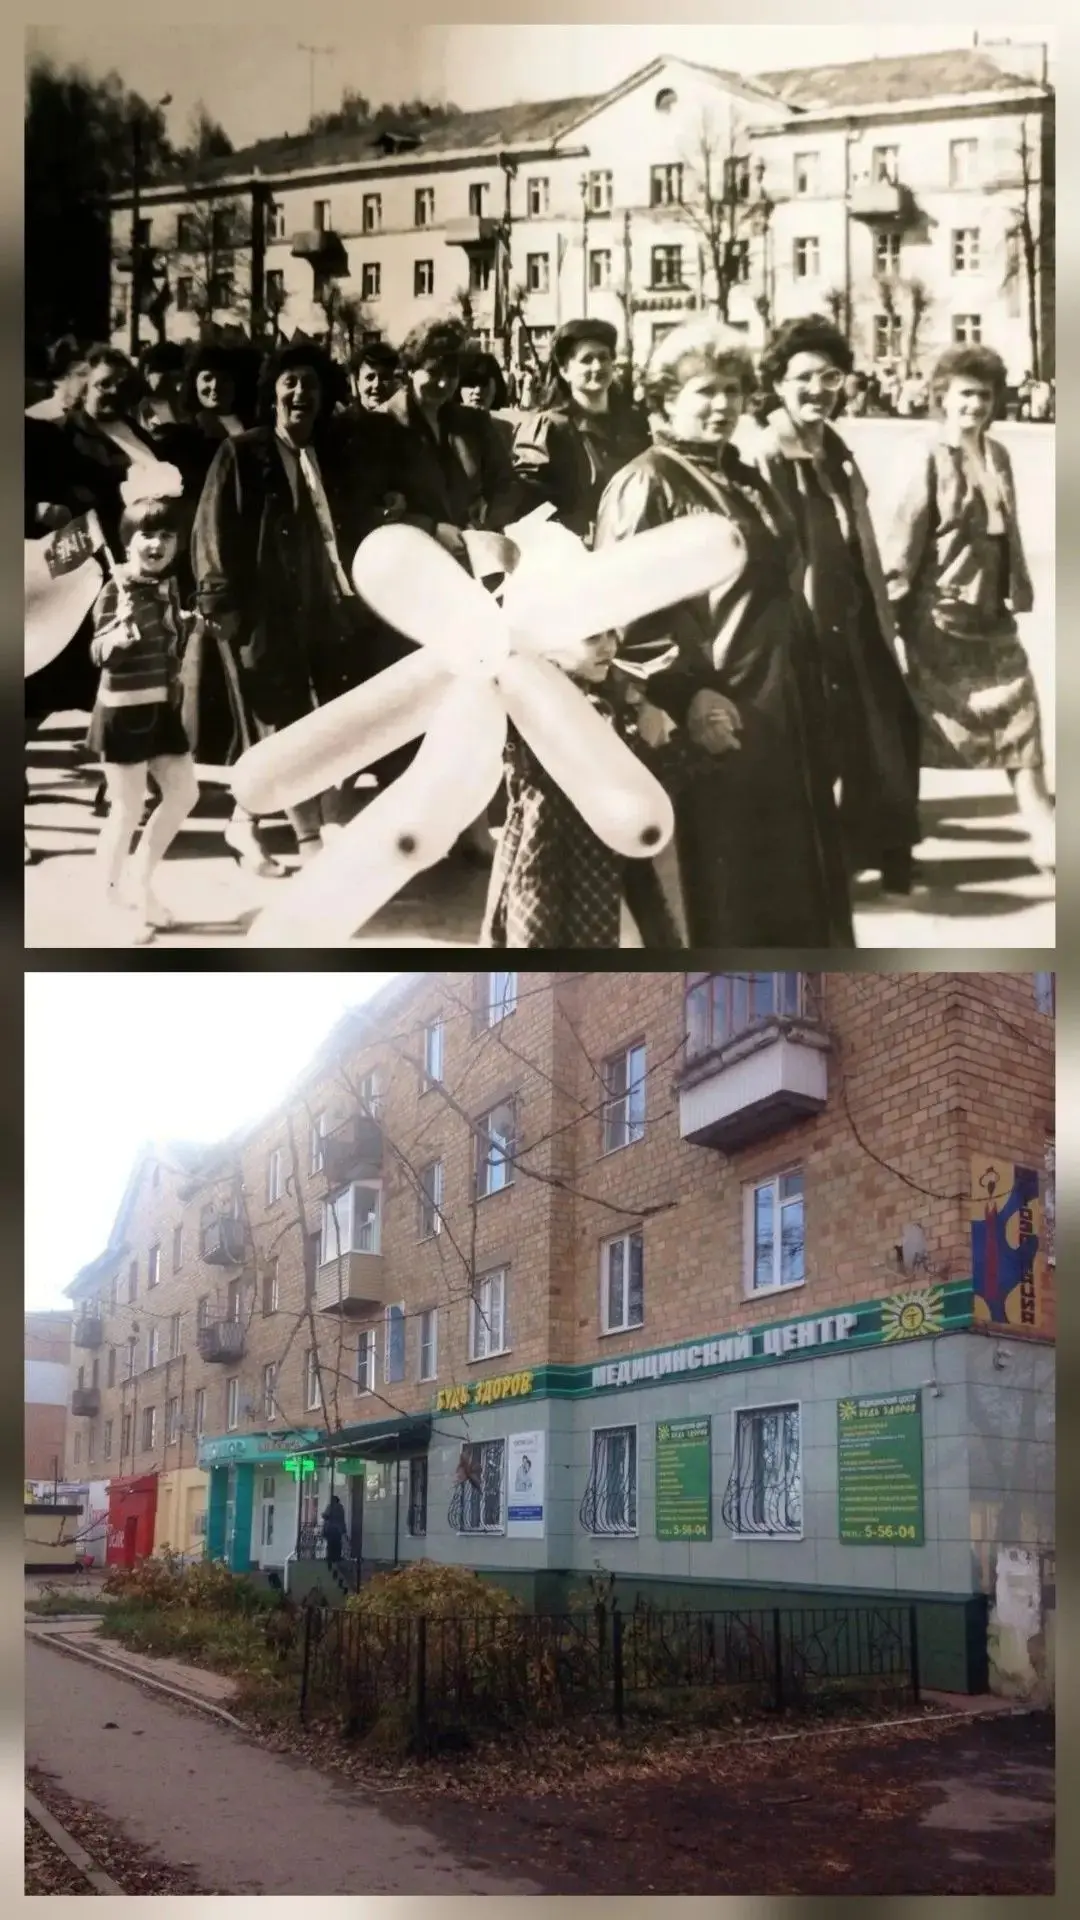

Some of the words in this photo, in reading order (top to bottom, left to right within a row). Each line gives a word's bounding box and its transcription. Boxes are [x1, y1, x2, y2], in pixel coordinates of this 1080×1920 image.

[592, 1326, 751, 1387] МЕДИЦИНСКИЙ
[763, 1313, 857, 1356] ЦЕНТР
[437, 1385, 470, 1411] БУДЬ
[475, 1371, 533, 1405] ЗДОРОВ
[864, 1524, 916, 1539] 5-56-04
